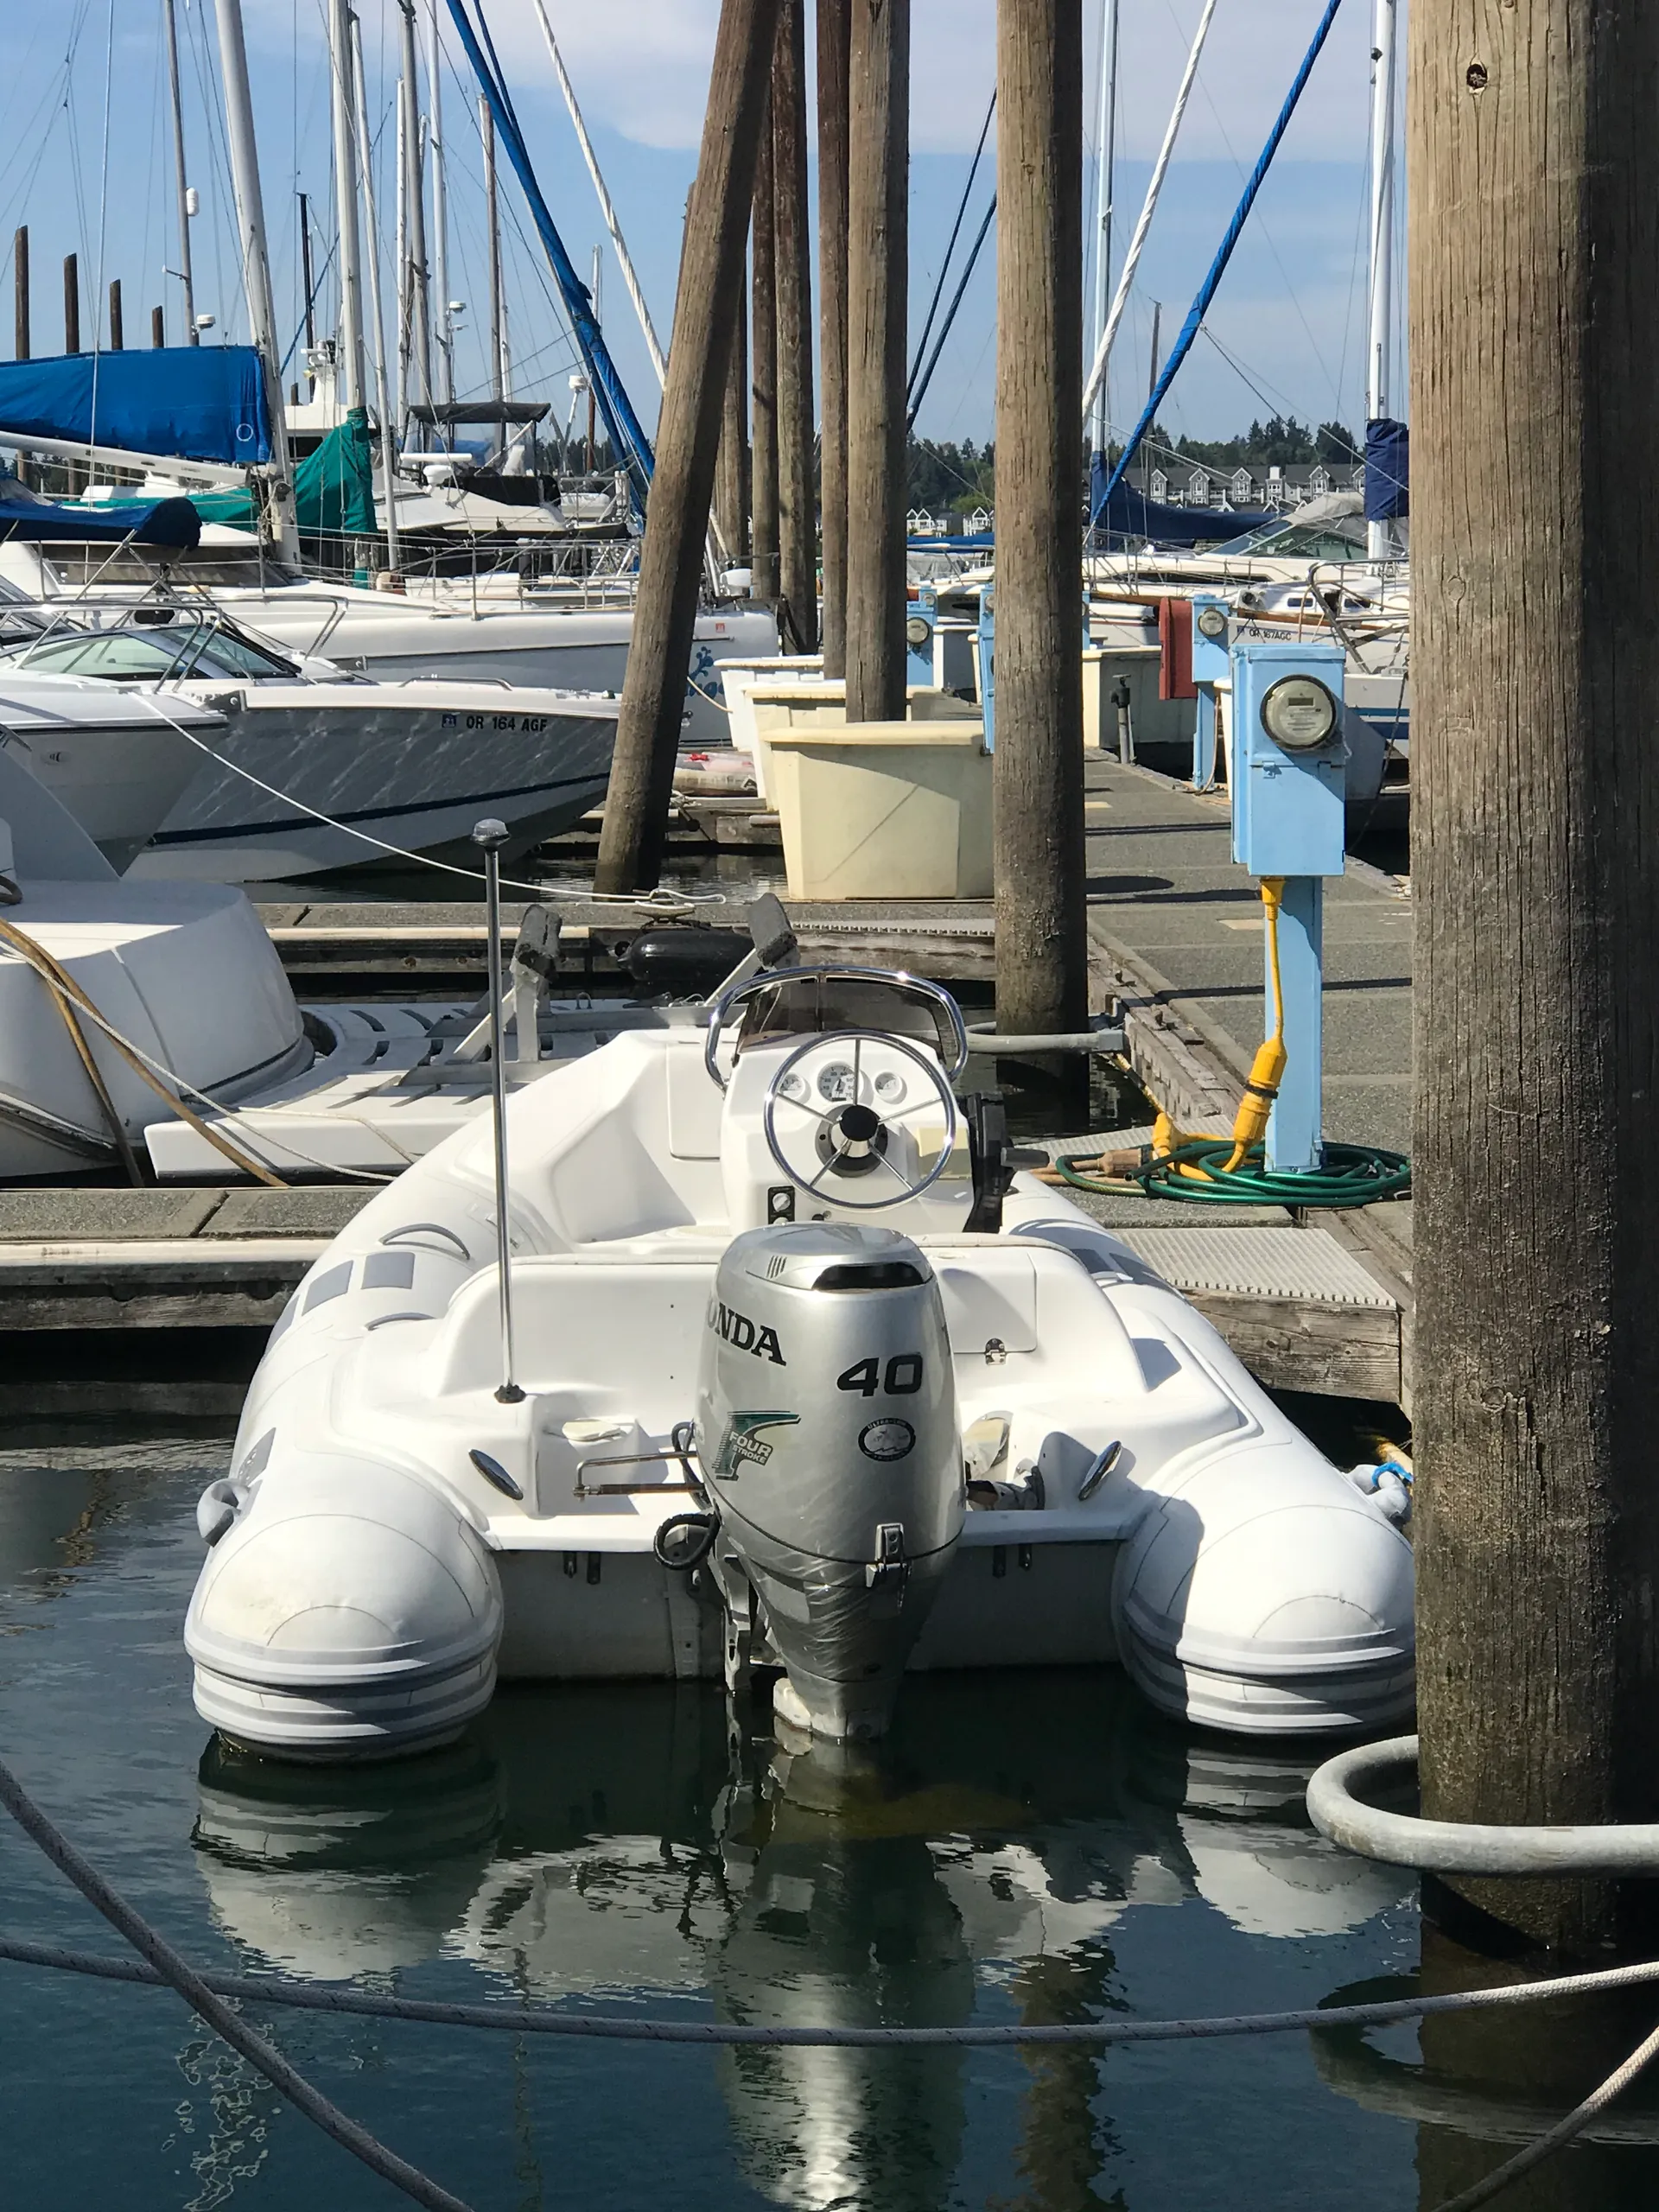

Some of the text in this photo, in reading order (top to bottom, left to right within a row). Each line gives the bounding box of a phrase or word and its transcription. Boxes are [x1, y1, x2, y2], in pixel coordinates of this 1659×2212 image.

[467, 715, 548, 733] OR 164 AGF
[707, 1298, 786, 1366] ONDA
[836, 1354, 923, 1397] 40
[729, 1431, 772, 1457] FOUR
[733, 1445, 766, 1464] STROKE
